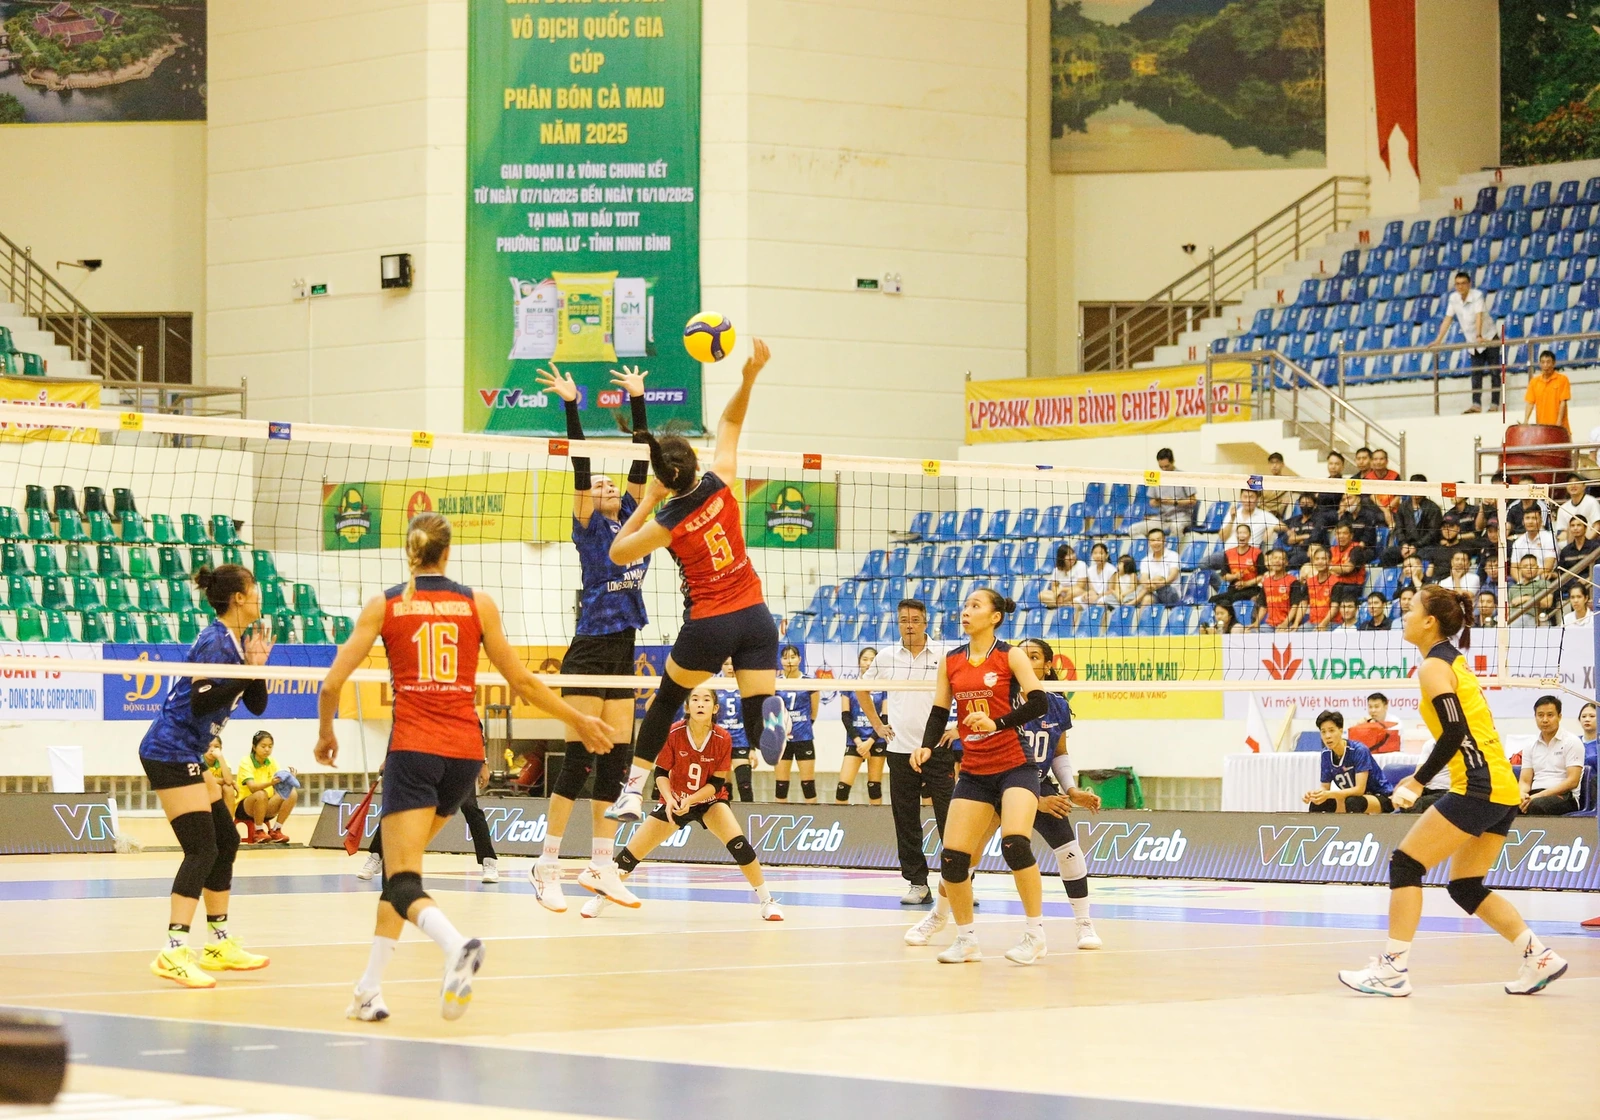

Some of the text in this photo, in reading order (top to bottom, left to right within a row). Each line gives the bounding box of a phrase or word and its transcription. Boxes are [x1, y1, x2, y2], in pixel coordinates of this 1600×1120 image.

[511, 10, 664, 43] VÔ ĐỊCH QUỐC GIA
[569, 48, 605, 73] CÚP
[504, 83, 664, 109] PHÂN BÓN CÀ MAU
[540, 119, 628, 144] NĂM 2025
[501, 159, 667, 182] GIAI ĐOẠN II & VÒNG CHUNG KẾT
[474, 184, 694, 204] TỪ NGÀY 07/10/2025 ĐẾN NGÀY 16/10/2025
[1454, 197, 1463, 210] N
[527, 208, 640, 230] TẠI NHÀ THI ĐẤU TDTT
[496, 234, 540, 252] PHƯỜNG
[542, 237, 563, 252] HOA
[566, 236, 581, 252] LƯ
[588, 232, 613, 251] TỈNH
[616, 236, 642, 251] NINH
[645, 233, 671, 251] BÌNH
[1358, 230, 1370, 244] M
[1319, 260, 1325, 274] L
[1277, 289, 1285, 304] K
[1188, 346, 1196, 361] H
[479, 388, 548, 408] VTVcab
[600, 394, 620, 404] ON
[969, 400, 1030, 429] LPBANK
[1034, 397, 1072, 426] NINH
[1078, 390, 1117, 425] BÌNH
[1122, 381, 1170, 422] CHIẾN
[438, 494, 458, 515] PHÂN
[460, 494, 473, 514] BÓN
[487, 494, 503, 513] MAU
[704, 522, 734, 571] 5
[411, 621, 459, 683] 16
[1086, 659, 1178, 681] PHÂN BÓN CÀ MAU
[9, 688, 28, 709] DONG
[31, 688, 45, 709] BAC
[47, 688, 97, 711] CORPORATION)
[123, 703, 144, 713] ĐỘNG
[726, 698, 735, 716] 5
[787, 692, 797, 711] 7
[1300, 696, 1320, 709] Việt
[1328, 697, 1349, 708] Nam
[687, 763, 702, 791] 9
[1335, 772, 1354, 790] 21
[748, 814, 845, 852] VTVcab
[1075, 821, 1188, 862] VTVcab
[1258, 825, 1381, 868] VTVcab
